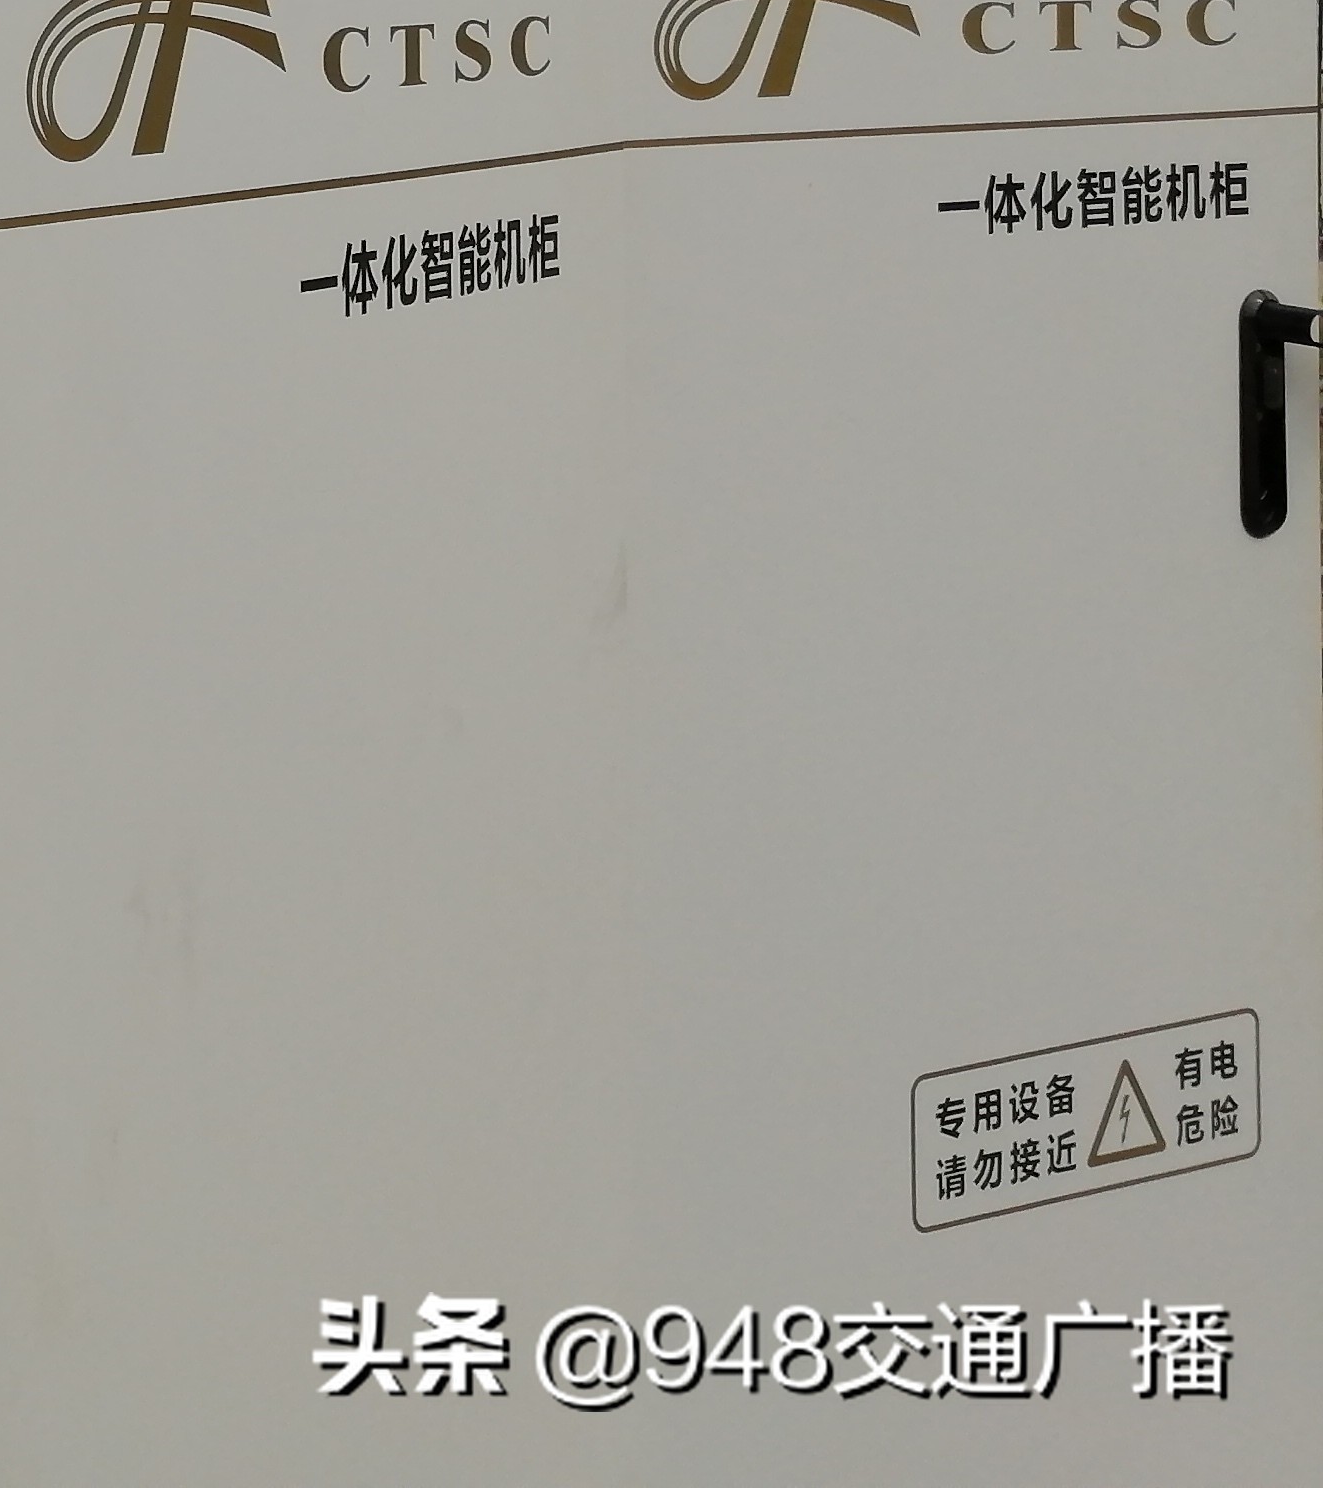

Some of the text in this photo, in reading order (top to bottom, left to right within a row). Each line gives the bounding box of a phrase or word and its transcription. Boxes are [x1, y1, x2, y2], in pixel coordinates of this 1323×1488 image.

[322, 15, 552, 94] CTSC
[937, 160, 1250, 235] 一体化智能机柜
[299, 213, 561, 317] 一体化智能机柜
[1174, 1039, 1239, 1091] 有电
[934, 1073, 1075, 1140] 专用设备
[1176, 1093, 1240, 1147] 危险
[936, 1129, 1077, 1201] 请勿接近
